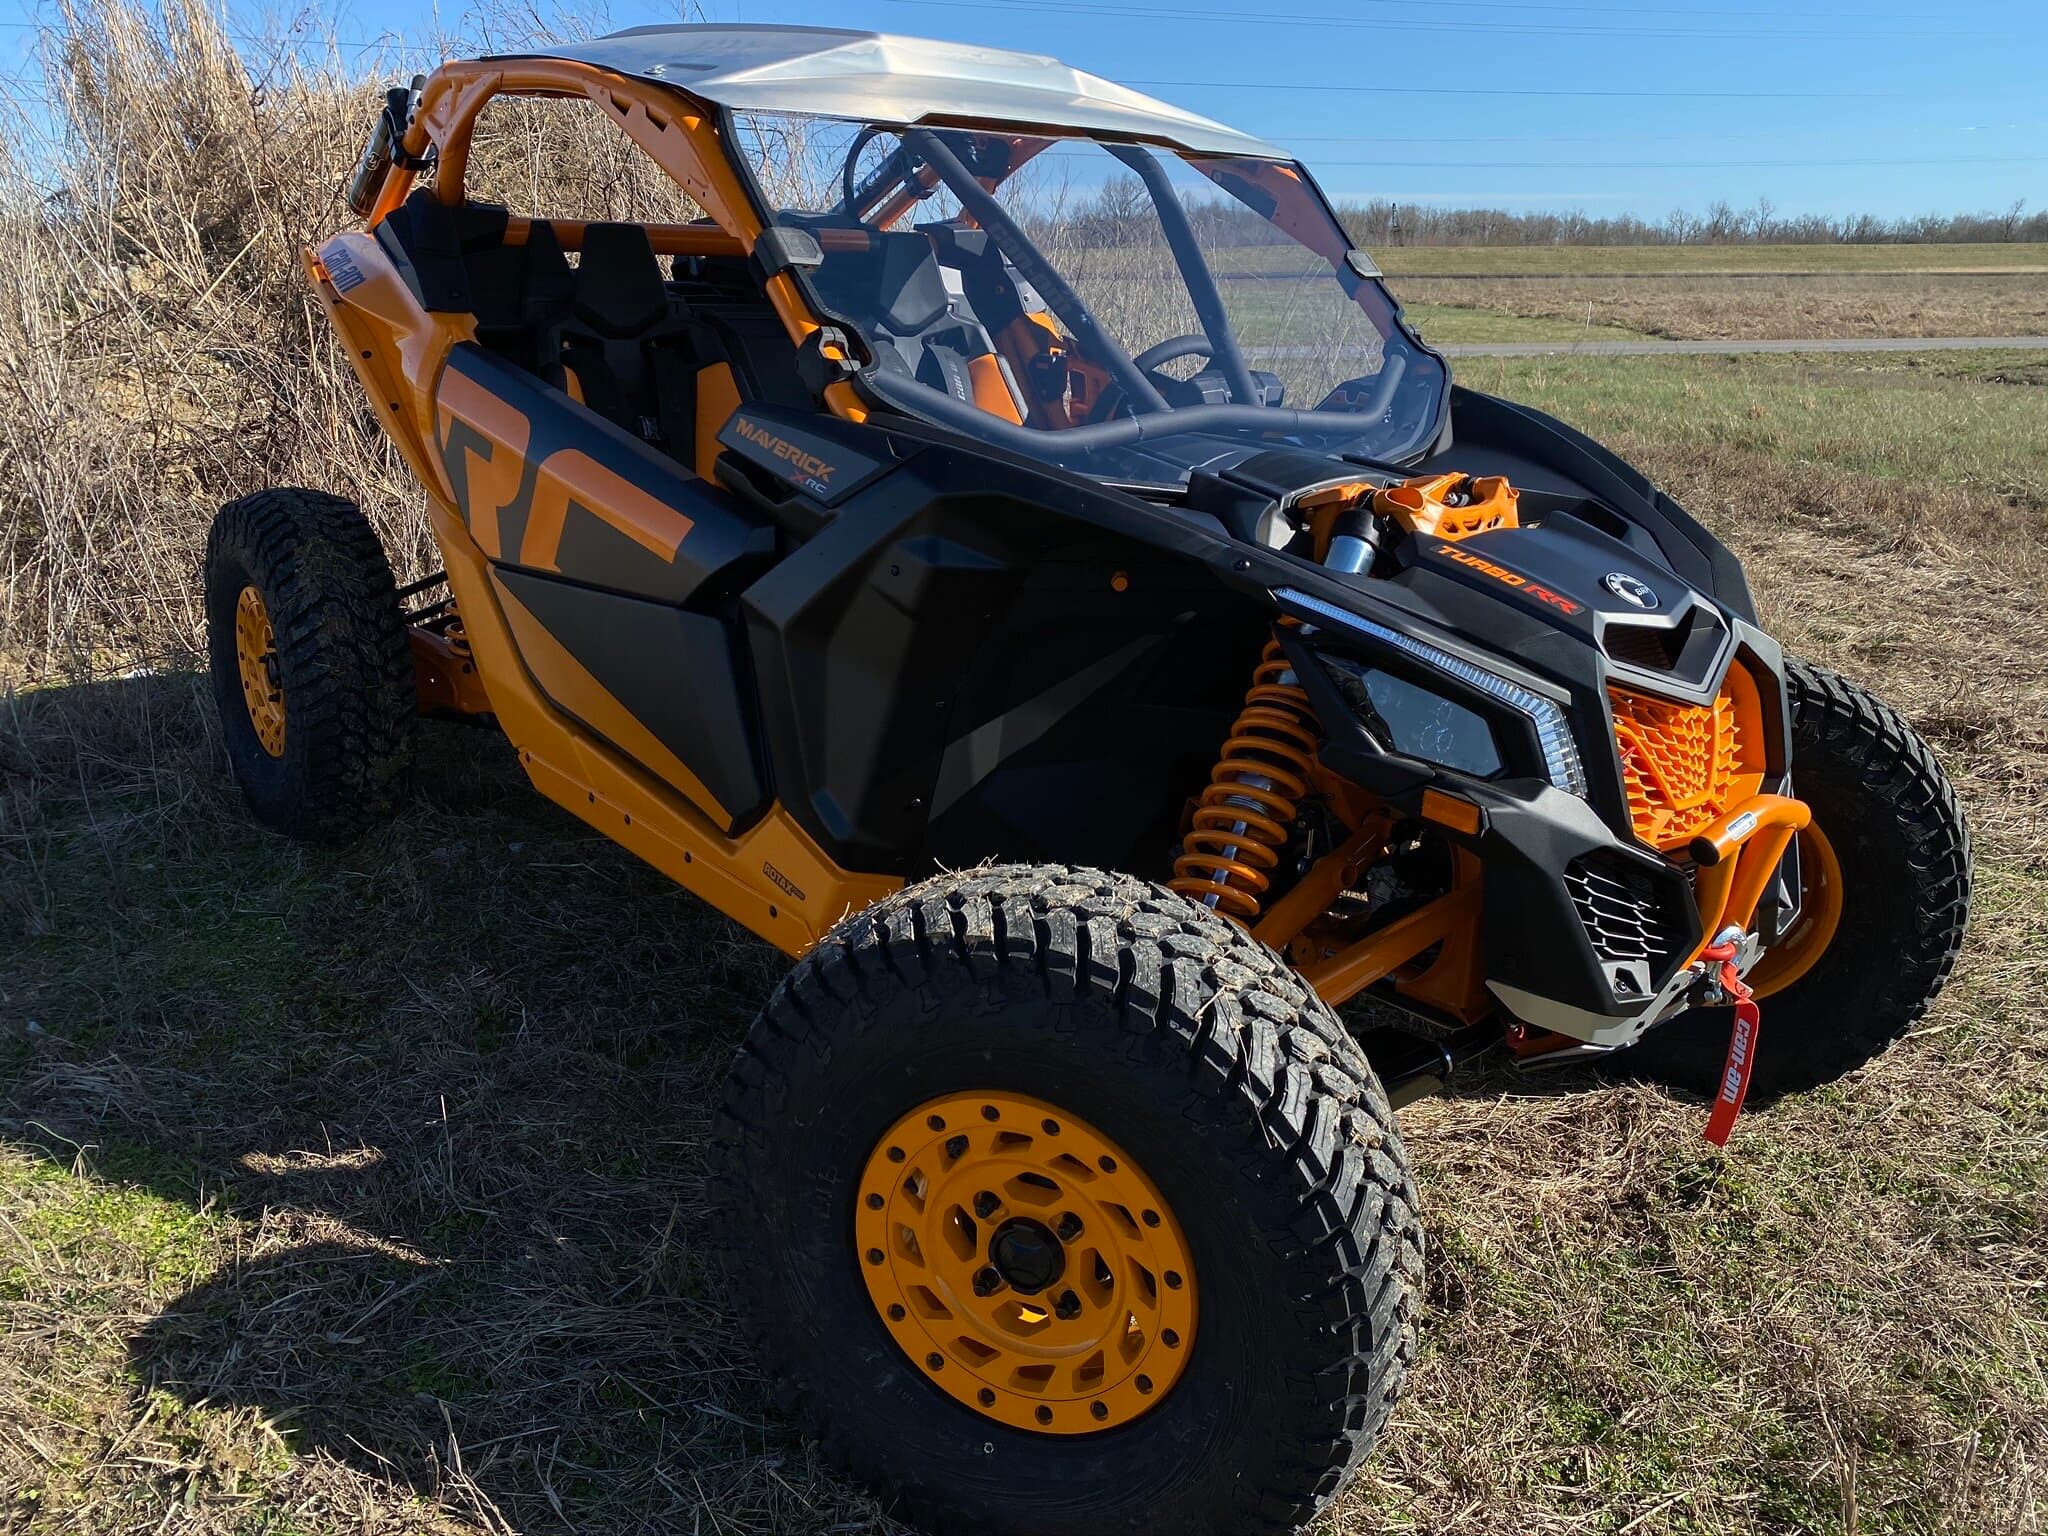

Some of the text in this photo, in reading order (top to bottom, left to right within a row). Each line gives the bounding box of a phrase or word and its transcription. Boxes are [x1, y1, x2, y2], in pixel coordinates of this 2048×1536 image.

[437, 364, 694, 573] RC
[736, 418, 835, 482] MAVERICK
[1438, 545, 1579, 616] TURBO RR
[764, 863, 793, 895] ROTAX
